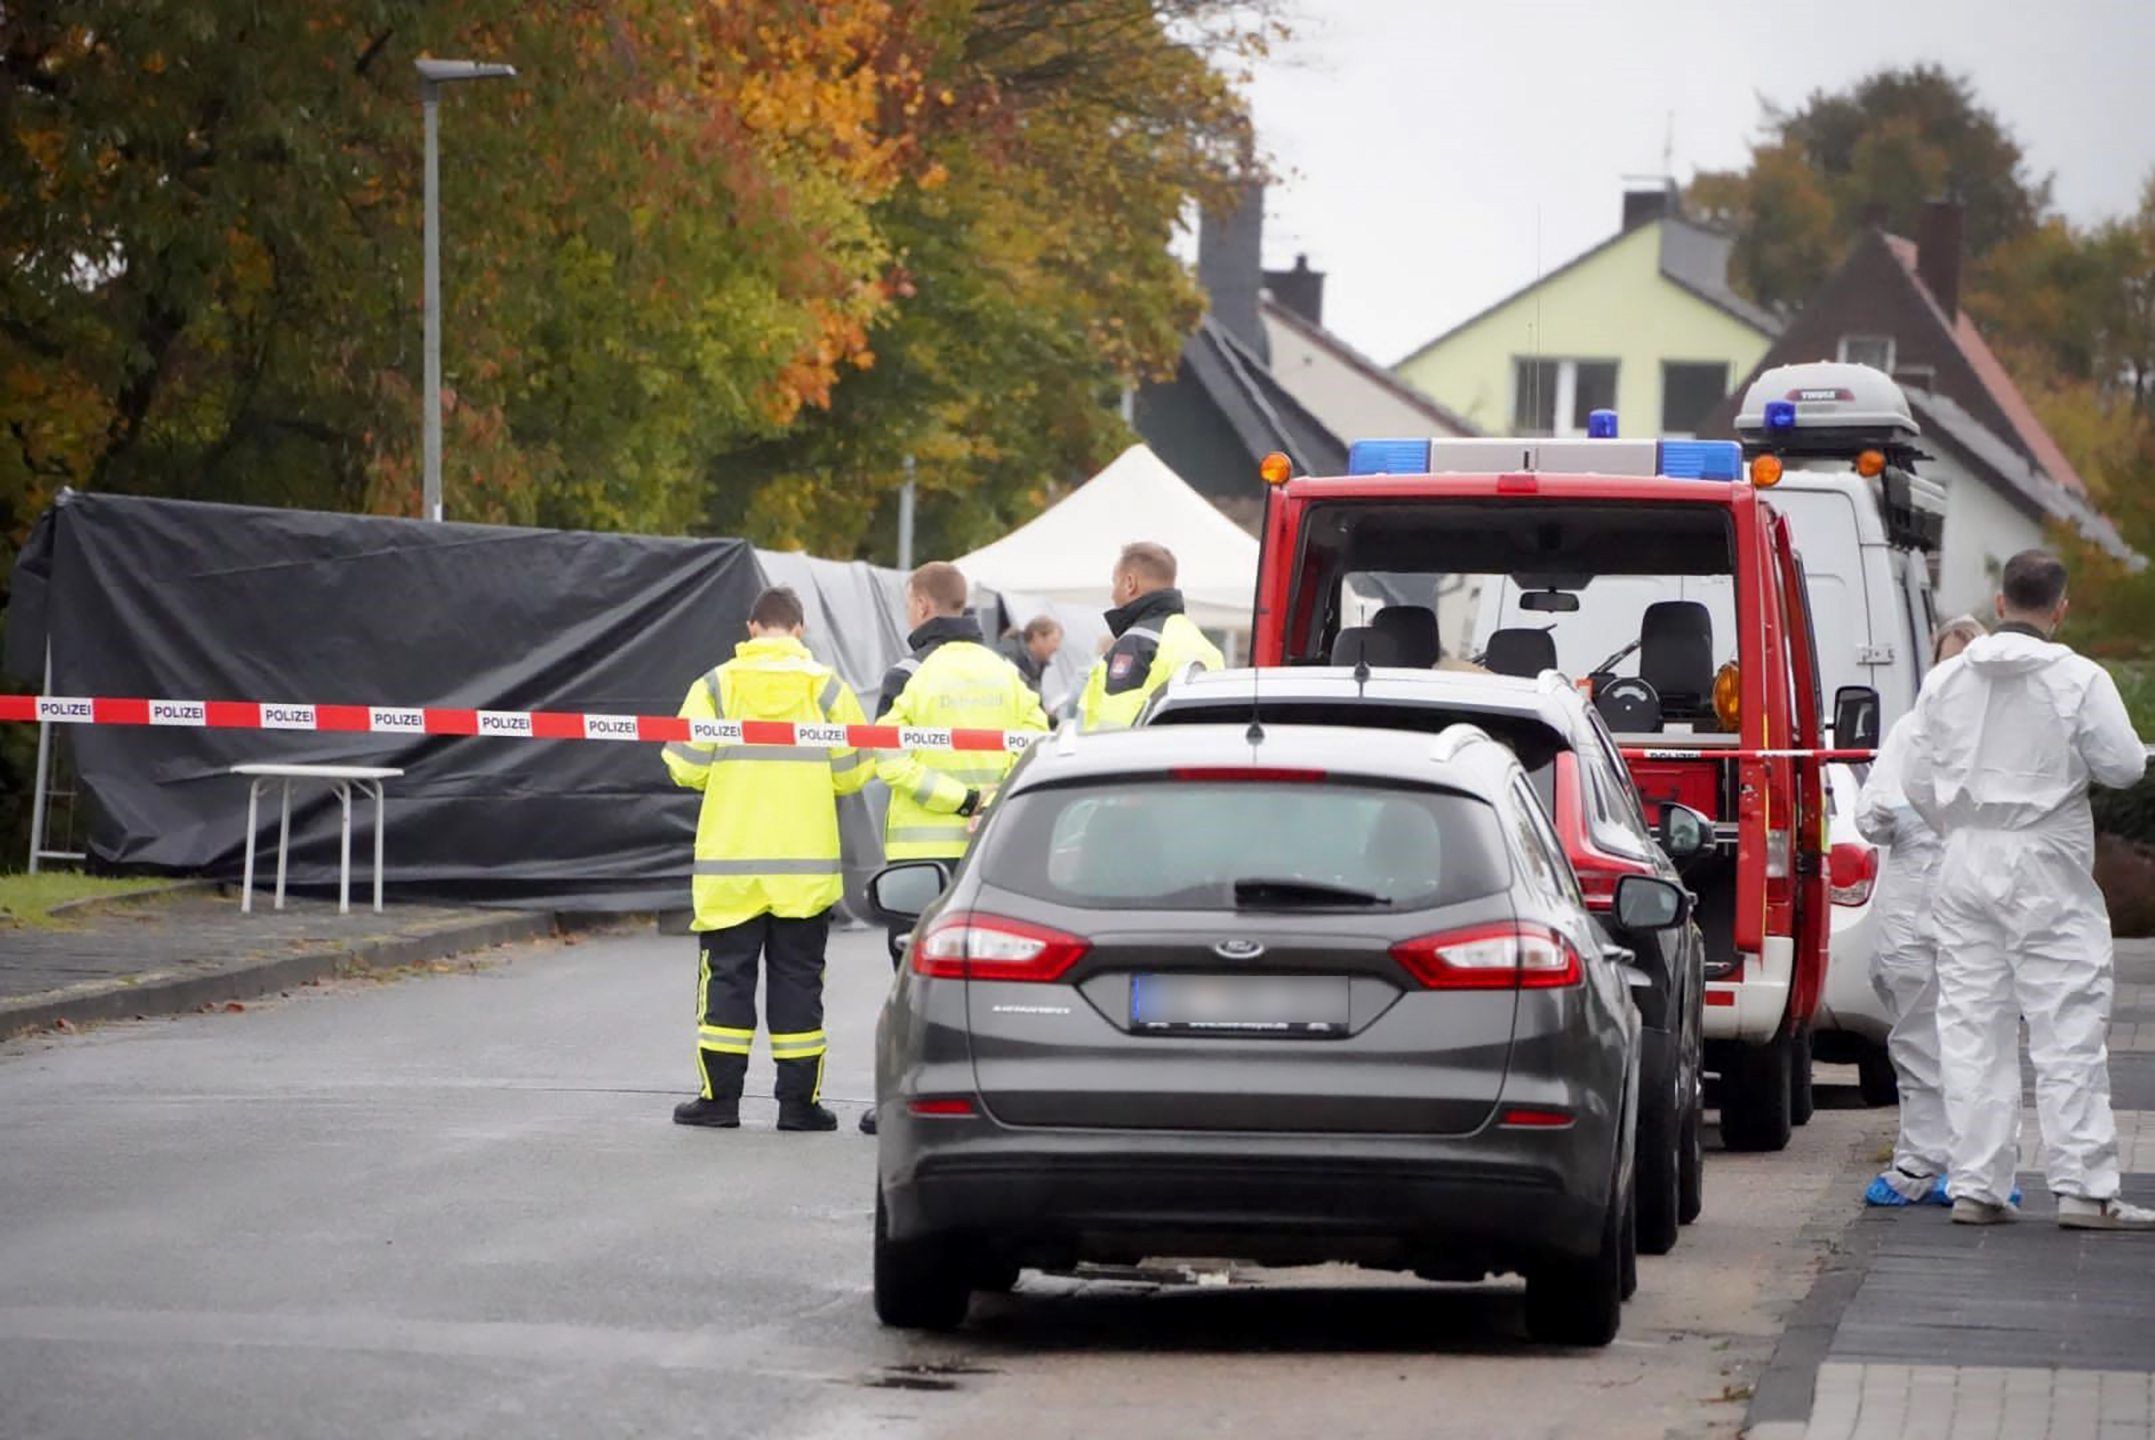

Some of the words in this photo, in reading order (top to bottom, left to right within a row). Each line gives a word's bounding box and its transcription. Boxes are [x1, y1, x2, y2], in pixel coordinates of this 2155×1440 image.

[41, 703, 91, 716] POLIZEI
[154, 705, 204, 719] POLIZEI
[265, 709, 314, 723] POLIZEI
[374, 713, 423, 727] POLIZEI
[482, 717, 530, 731] POLIZEI
[589, 720, 636, 733] POLIZEI
[694, 724, 741, 737] POLIZEI
[799, 729, 845, 742] POLIZEI
[904, 733, 950, 745] POLIZEI
